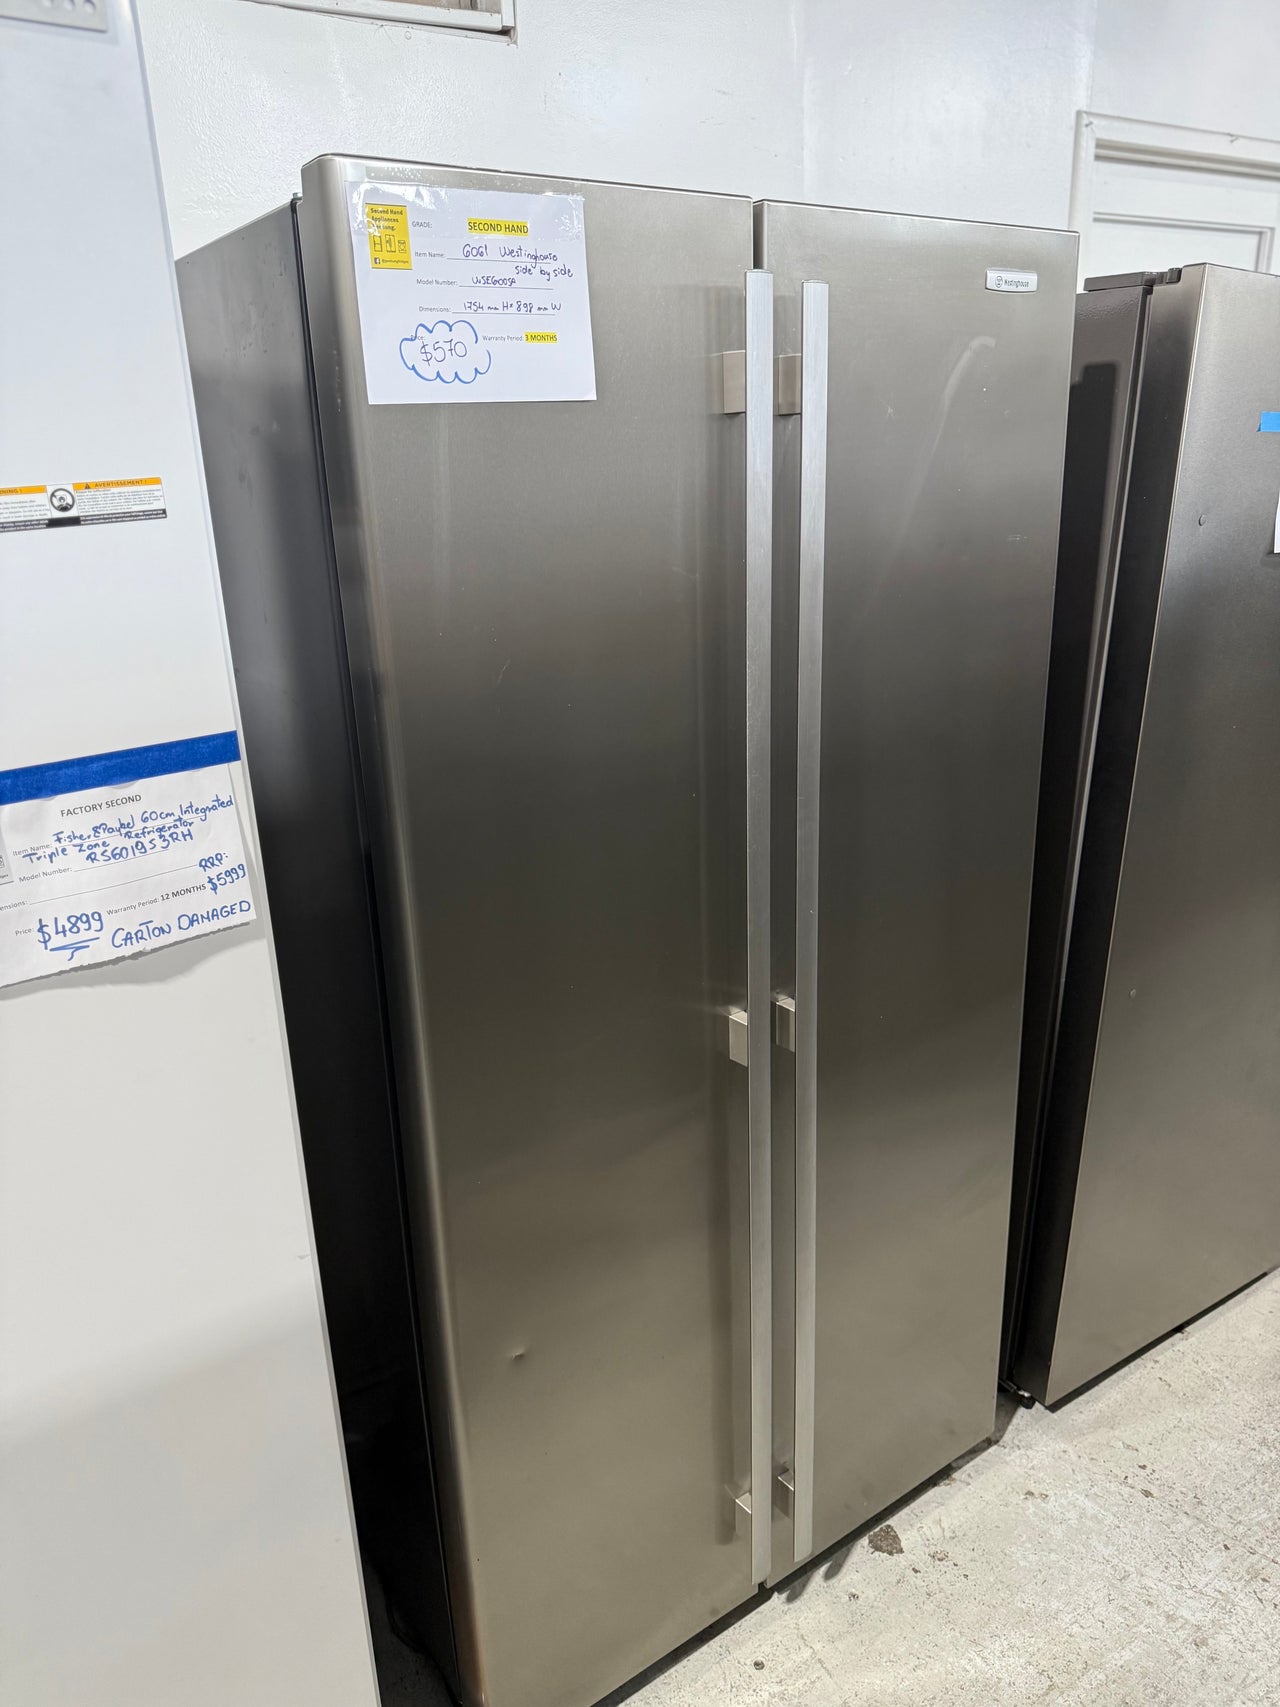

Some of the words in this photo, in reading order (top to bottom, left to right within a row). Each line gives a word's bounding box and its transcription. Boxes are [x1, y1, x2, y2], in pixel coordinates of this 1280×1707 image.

[468, 221, 502, 232] SECOND
[504, 224, 529, 234] HAND
[515, 265, 533, 275] side
[540, 266, 551, 282] by
[553, 264, 573, 278] side
[463, 301, 484, 312] 1754
[551, 302, 561, 311] W
[530, 334, 558, 342] MONTHS
[419, 338, 468, 366] $570
[60, 802, 103, 818] FACTORY
[105, 794, 142, 809] SECOND
[13, 849, 28, 857] Item
[30, 843, 53, 853] Name:
[52, 830, 91, 844] Fisher
[180, 794, 234, 821] Integrated
[22, 847, 68, 863] Triple
[72, 840, 110, 853] Zone
[123, 815, 194, 839] Refrigerator
[198, 852, 229, 872] RRP:
[19, 873, 41, 883] Model
[42, 867, 73, 877] Number:
[106, 903, 137, 916] Warranty
[137, 898, 160, 908] Period:
[160, 893, 170, 901] 12
[171, 883, 207, 898] MONTHS
[207, 863, 247, 895] $5999
[15, 928, 35, 936] Price:
[37, 911, 104, 950] $4899
[111, 920, 172, 948] CARTON
[177, 900, 251, 930] DAMAGED
